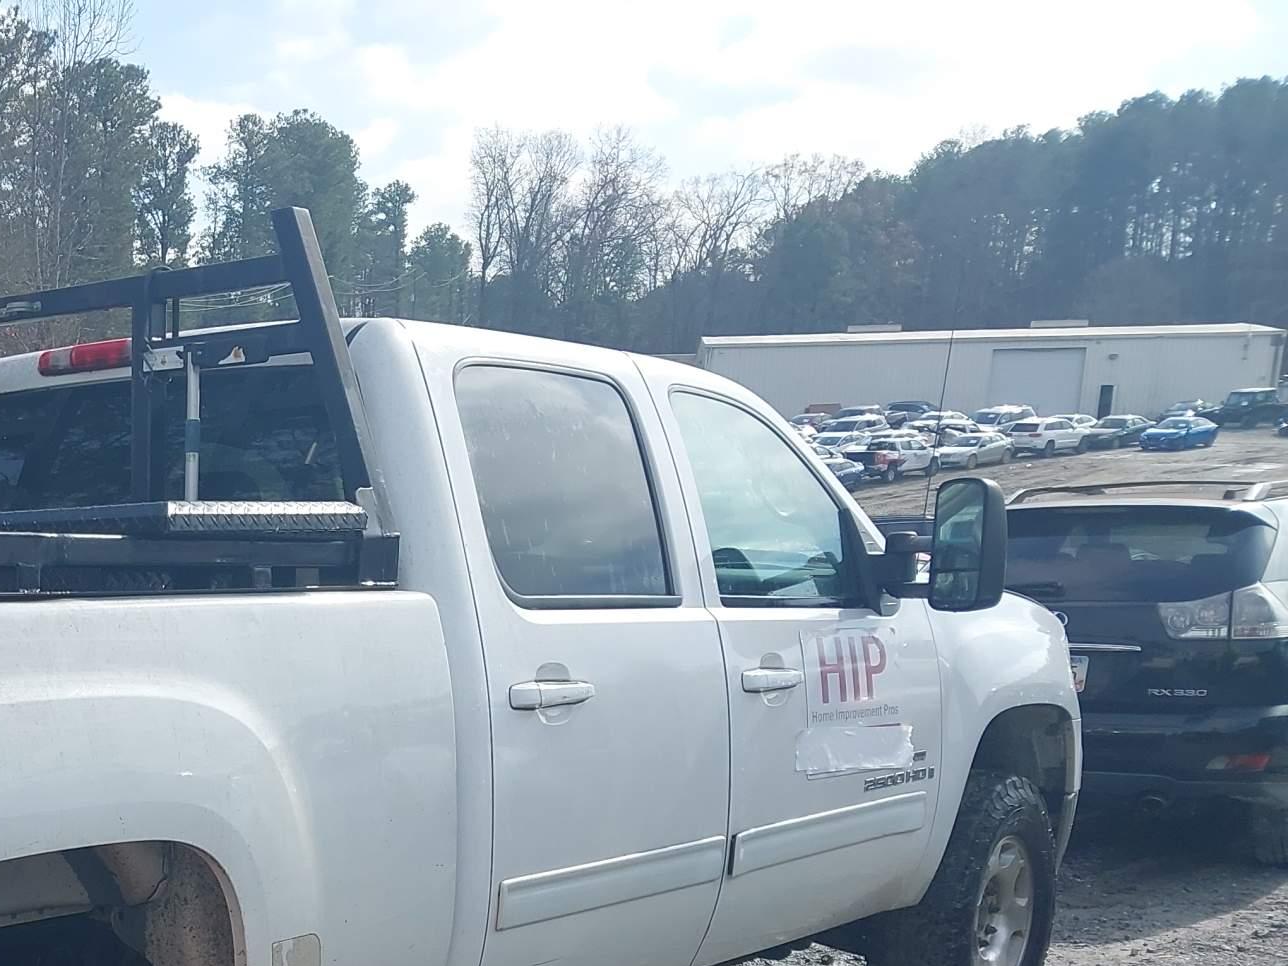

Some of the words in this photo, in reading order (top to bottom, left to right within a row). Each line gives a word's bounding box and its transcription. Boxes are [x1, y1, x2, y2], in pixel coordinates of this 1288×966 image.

[816, 635, 887, 704] HIP
[1148, 688, 1172, 697] RX
[1173, 688, 1208, 697] 330
[812, 711, 834, 723] Home
[835, 706, 882, 720] Improvement
[883, 703, 899, 715] Pros
